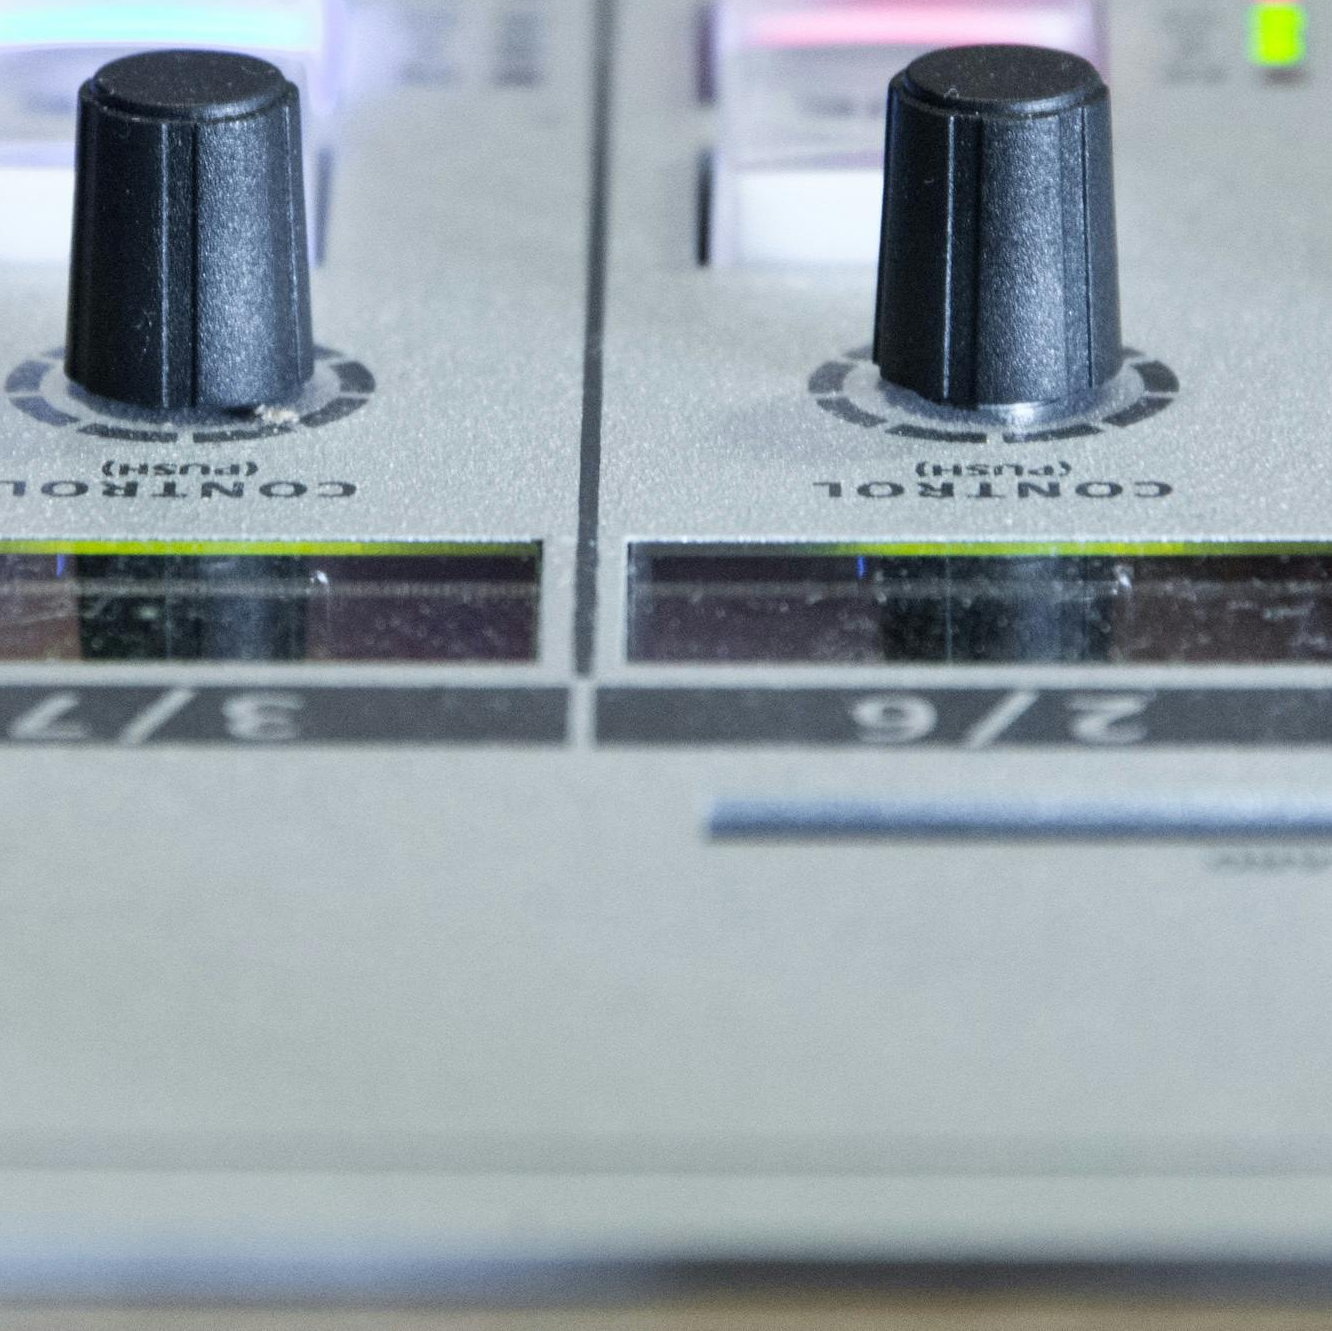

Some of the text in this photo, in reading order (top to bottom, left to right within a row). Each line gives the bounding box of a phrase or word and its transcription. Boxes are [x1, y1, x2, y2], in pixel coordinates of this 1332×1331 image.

[100, 459, 259, 477] (PUSH)
[913, 460, 1072, 479] (PUSH)
[812, 481, 1175, 500] CONTROL
[5, 686, 308, 745] 3/7
[850, 689, 1151, 749] 2/6
